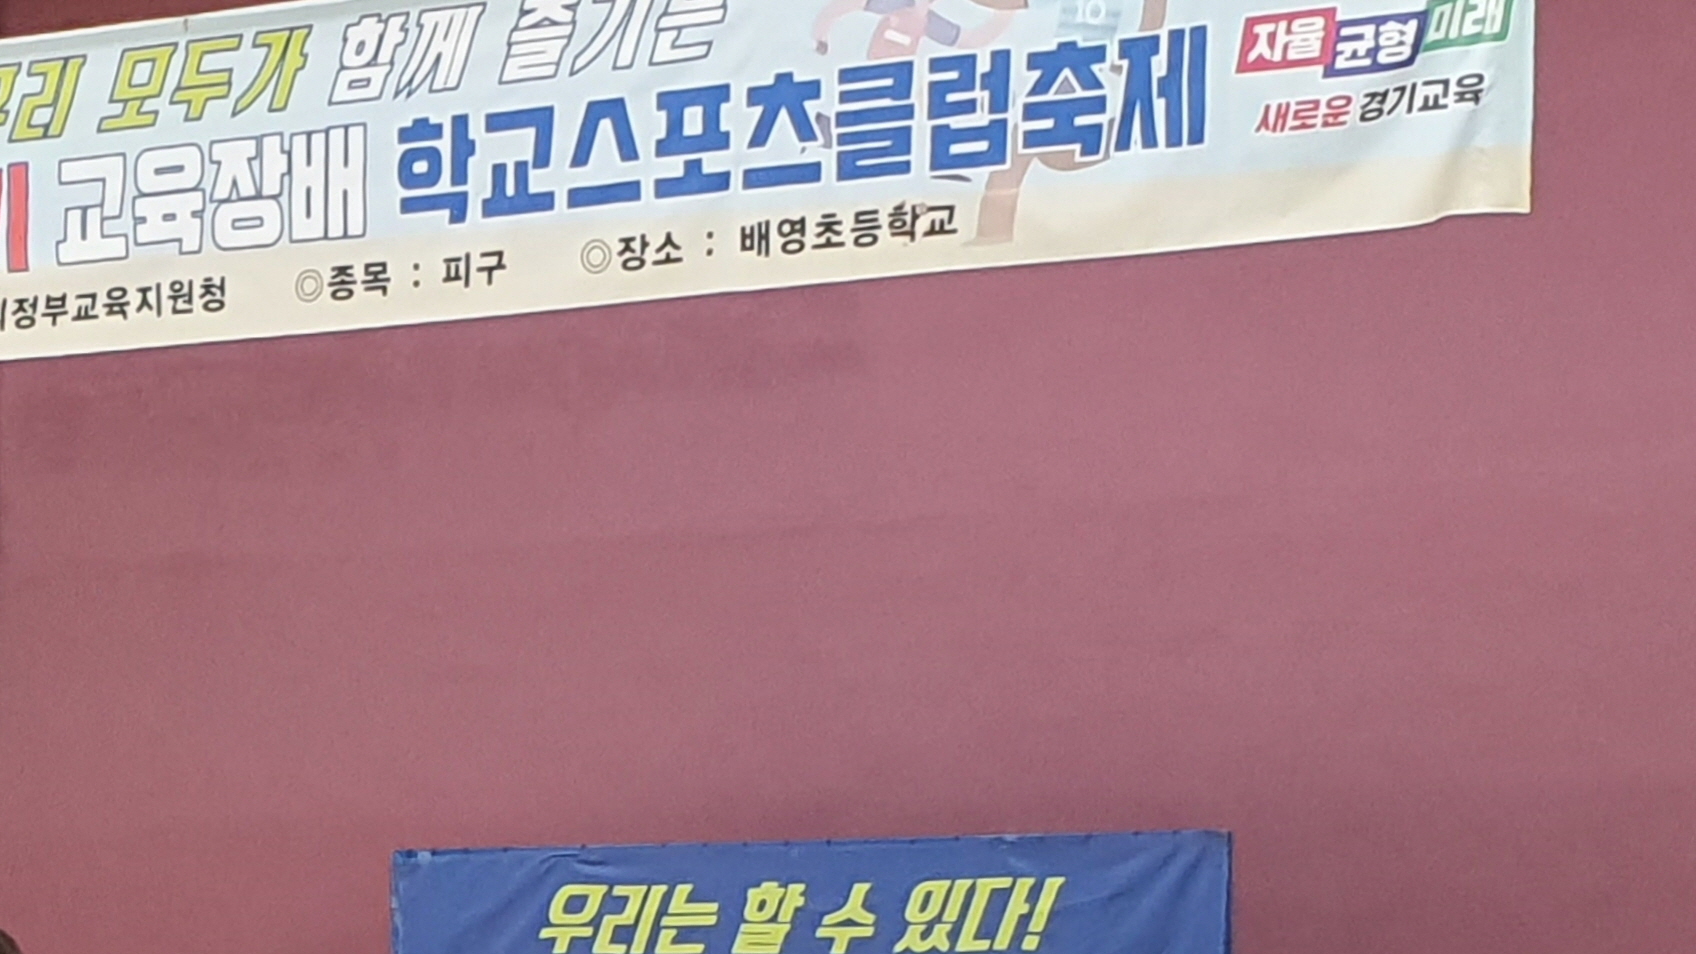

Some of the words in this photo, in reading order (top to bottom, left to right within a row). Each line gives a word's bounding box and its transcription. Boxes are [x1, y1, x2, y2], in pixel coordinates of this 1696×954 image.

[96, 24, 312, 134] 모두가
[328, 1, 485, 106] 함께
[498, 0, 727, 85] 즐기는
[1247, 16, 1325, 63] 자율
[1334, 19, 1418, 70] 균형
[1425, 0, 1506, 41] 미래
[1255, 95, 1353, 133] 새로운
[1359, 73, 1485, 123] 경기교육
[56, 122, 368, 266] 교육장배
[398, 24, 1207, 224] 학교스포츠클럽축제
[739, 202, 958, 259] 배영초등학교
[442, 249, 507, 289] 피구
[538, 883, 719, 954] 우리는
[731, 881, 806, 954] 할
[815, 882, 877, 954] 수
[892, 876, 1066, 953] 있다!
